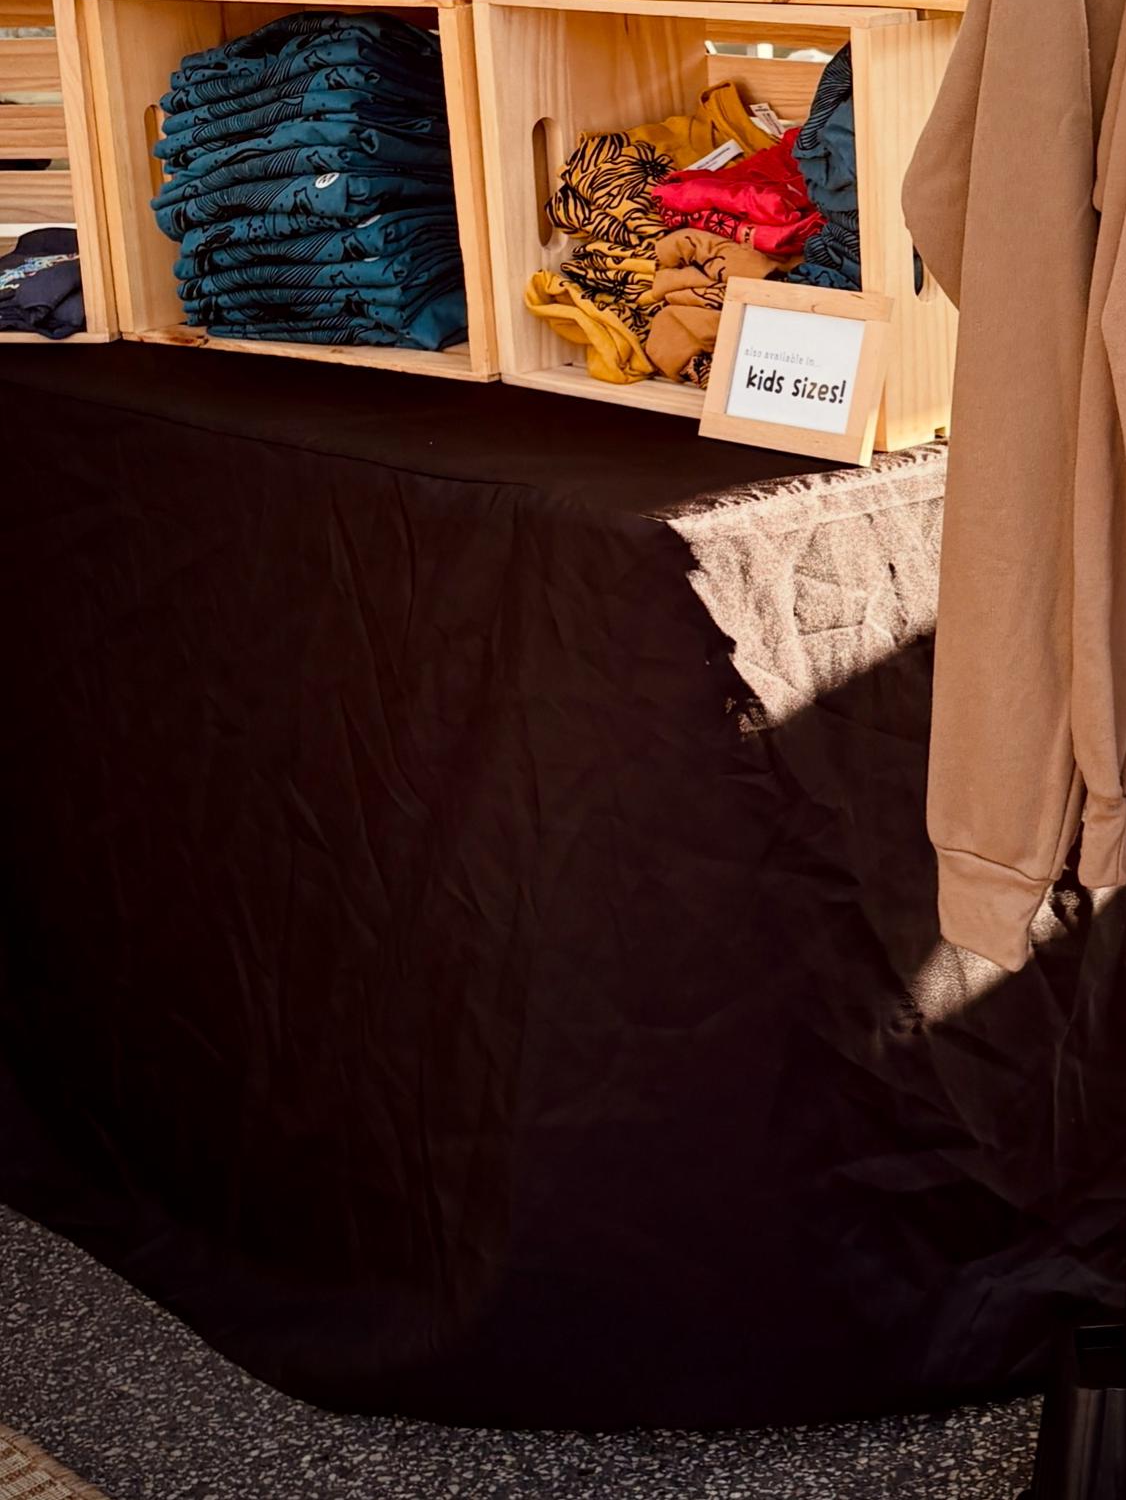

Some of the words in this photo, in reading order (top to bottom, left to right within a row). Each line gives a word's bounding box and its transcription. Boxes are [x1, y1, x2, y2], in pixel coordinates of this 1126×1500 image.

[744, 347, 762, 358] also
[764, 351, 804, 365] available
[746, 365, 785, 394] kids
[791, 377, 847, 404] sizes!
